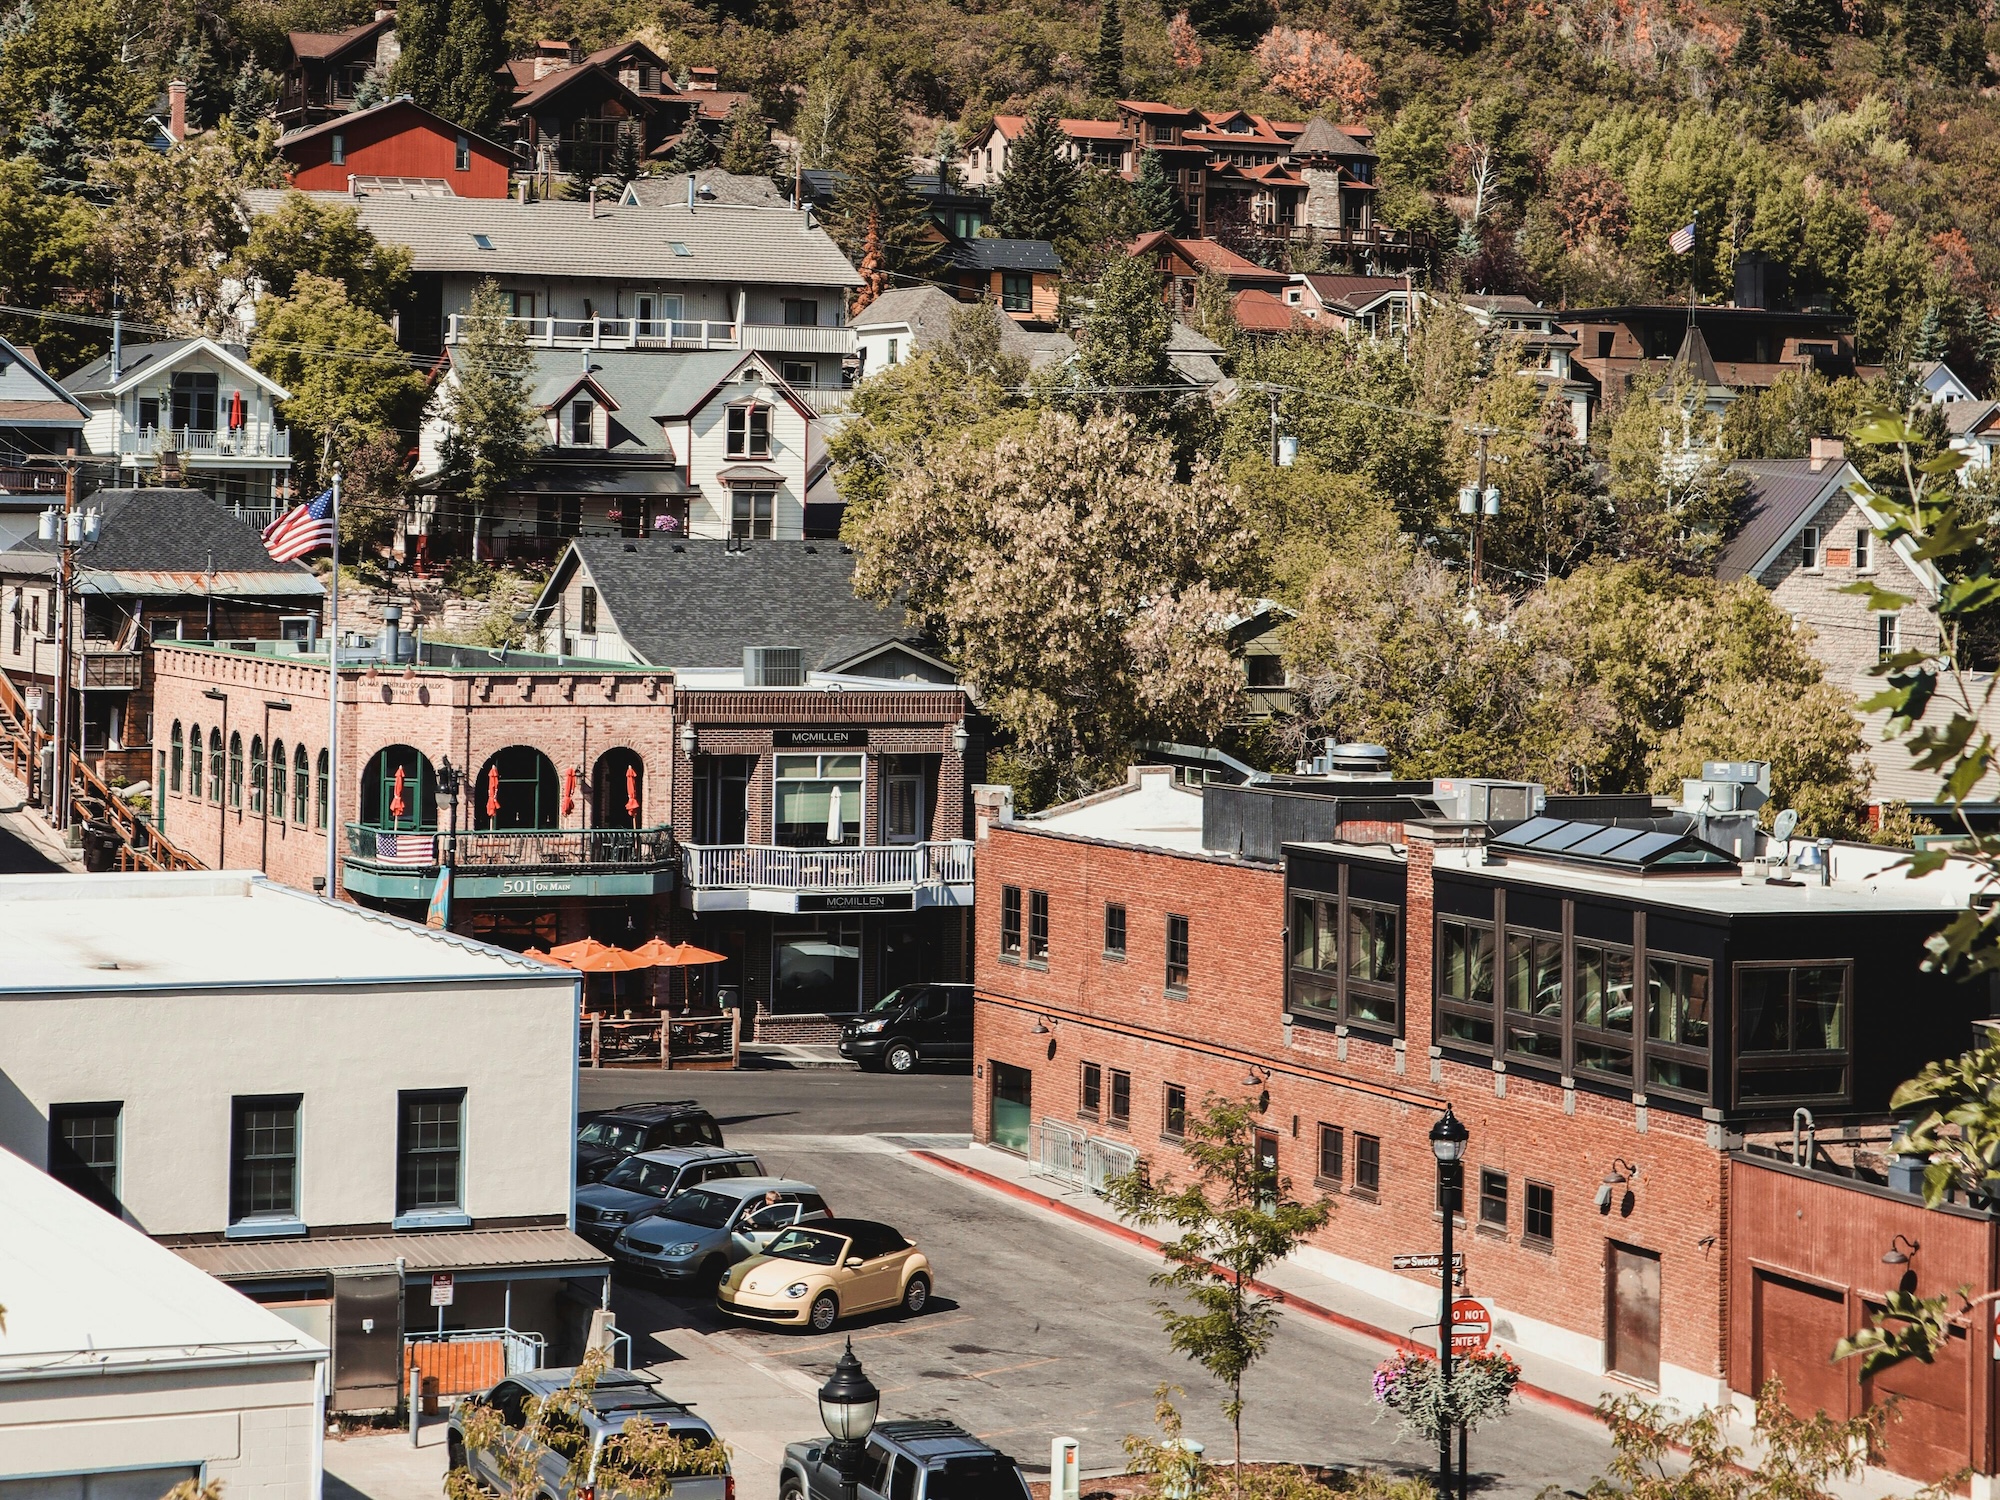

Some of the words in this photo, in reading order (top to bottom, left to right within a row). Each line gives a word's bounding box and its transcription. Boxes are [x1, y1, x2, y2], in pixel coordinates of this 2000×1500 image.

[791, 732, 849, 740] MCMILLEN
[502, 880, 532, 893] 501
[826, 896, 885, 905] MCMILLEN
[1410, 1256, 1439, 1267] Swede
[1464, 1310, 1486, 1320] NOT
[1451, 1335, 1480, 1347] ENTER
